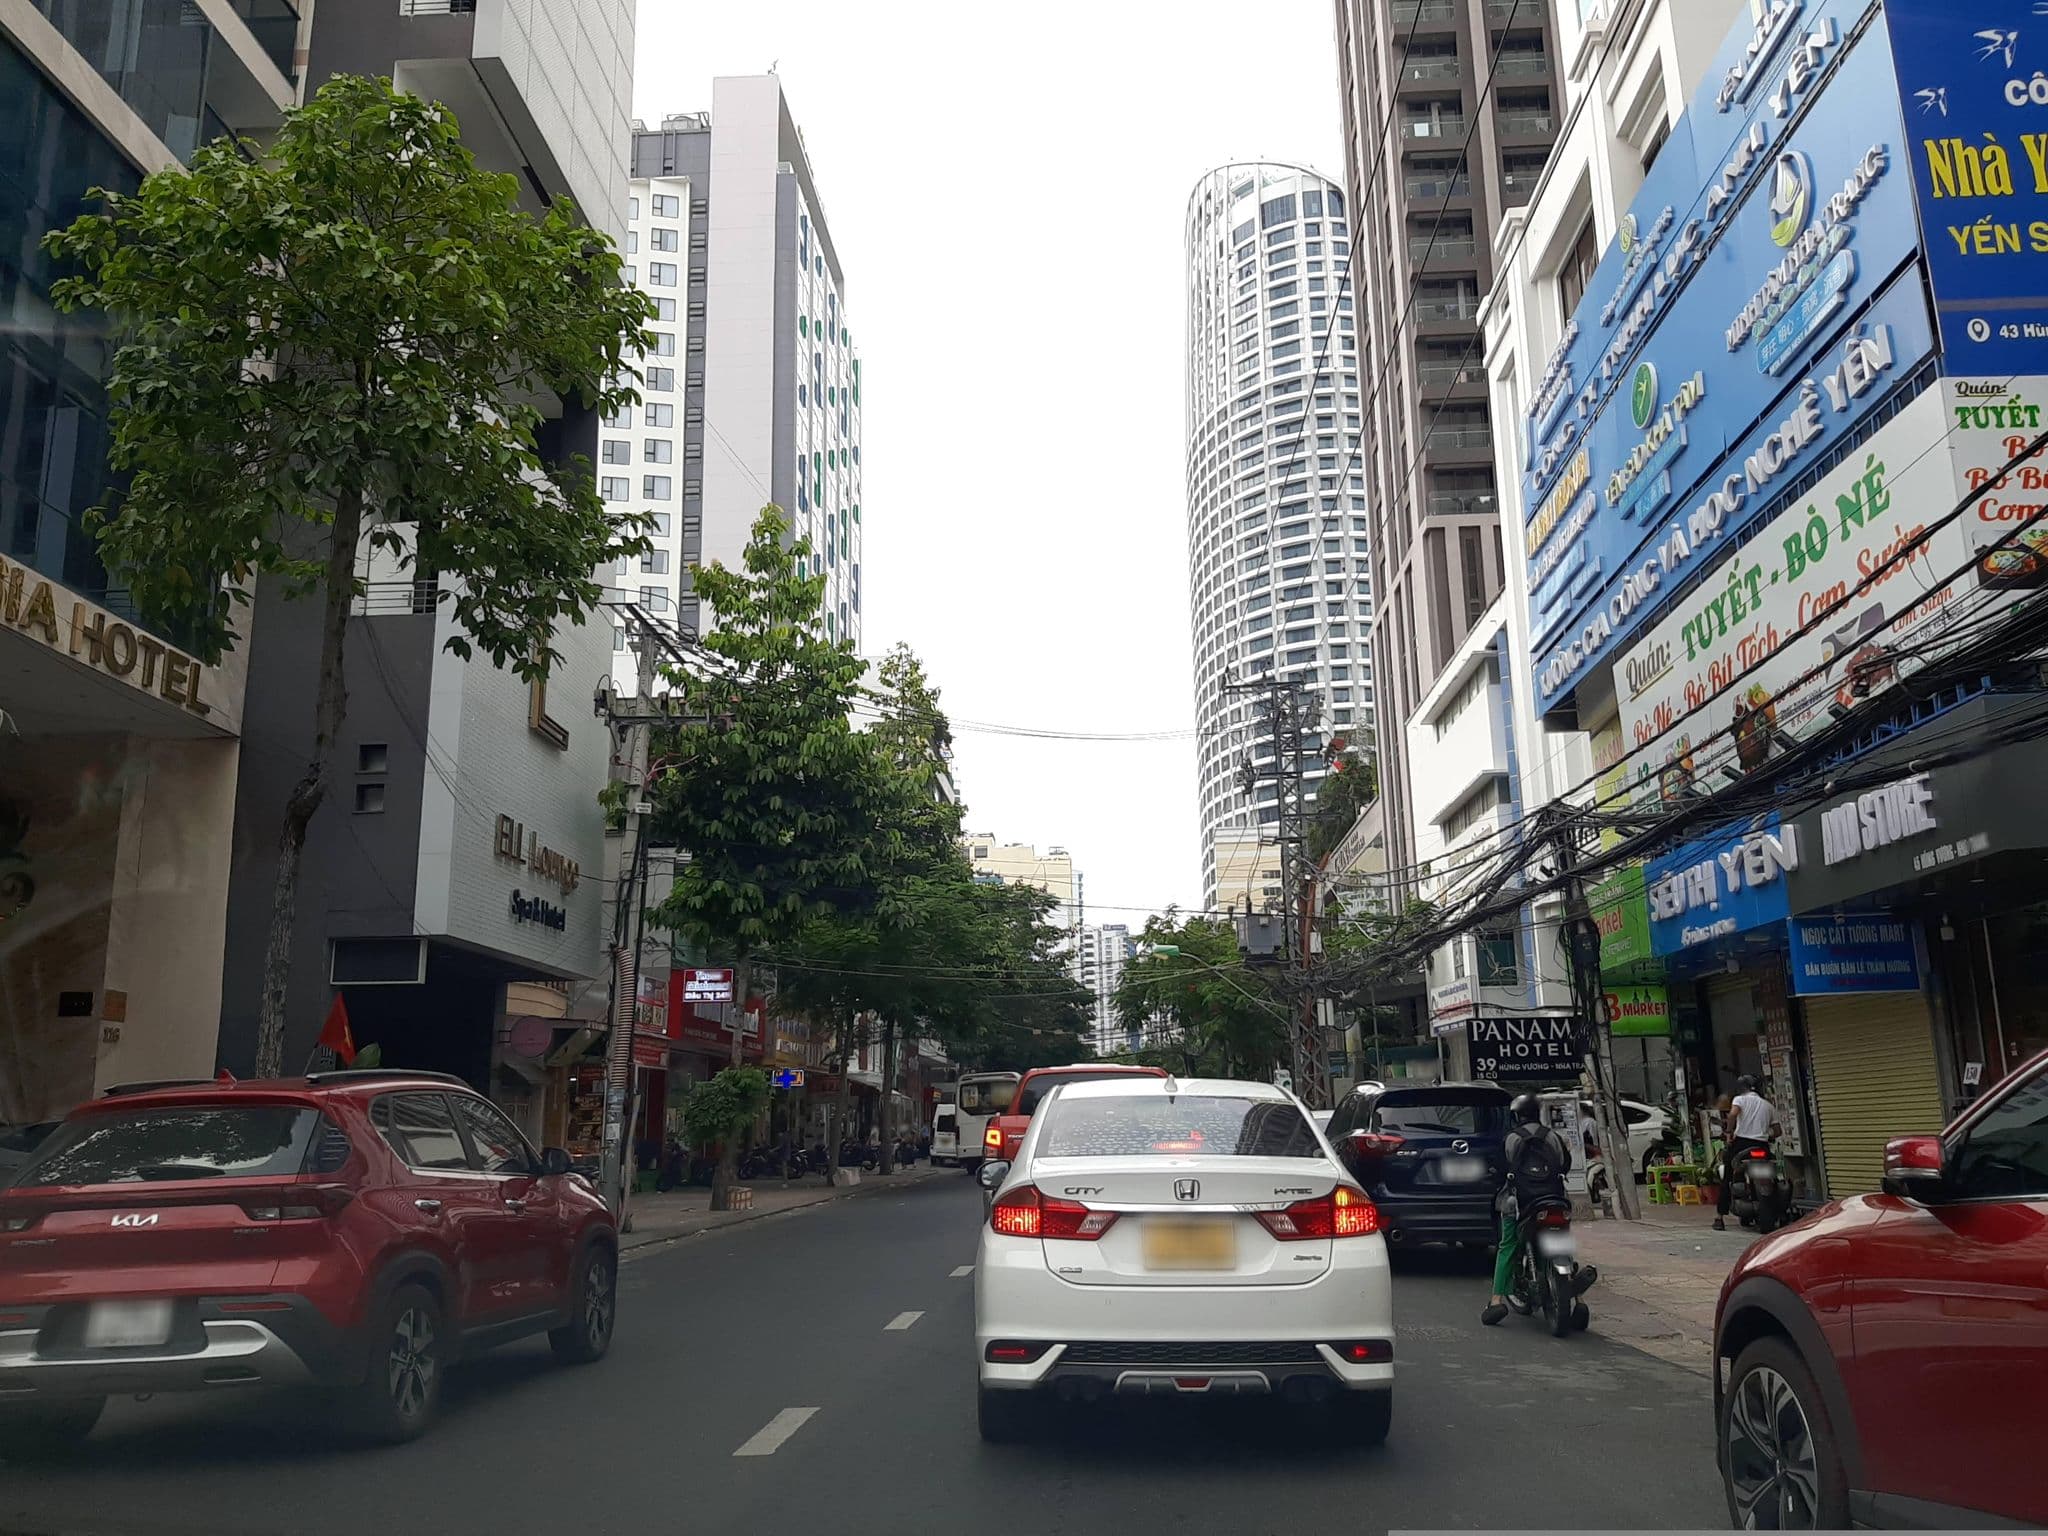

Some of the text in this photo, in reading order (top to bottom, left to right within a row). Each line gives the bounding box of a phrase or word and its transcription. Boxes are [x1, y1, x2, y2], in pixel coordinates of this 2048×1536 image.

[1924, 132, 2014, 199] Nhà
[1822, 144, 1885, 239] TRANG
[1533, 420, 1575, 490] CÔNG
[1575, 377, 1600, 419] TY
[1768, 17, 1834, 118] YẾN
[1947, 214, 2022, 256] YẾN
[1999, 324, 2019, 338] 43
[1954, 380, 2008, 396] Quán:
[1954, 394, 2042, 430] TUYẾT
[1610, 557, 1661, 627] CÔNG
[1657, 522, 1691, 573] VÀ
[1688, 473, 1746, 548] HỌC
[1743, 377, 1825, 495] NGHỀ
[1823, 322, 1895, 413] YẾN
[1625, 639, 1672, 694] Quán:
[1681, 558, 1762, 662] TUYẾT
[1783, 504, 1829, 583] BÒ
[1835, 453, 1890, 543] NÉ
[70, 602, 211, 715] HOTEL
[1633, 713, 1653, 746] Bò
[1653, 696, 1673, 735] Né
[1683, 673, 1708, 713] Bò
[1707, 652, 1734, 695] Bít
[1736, 622, 1778, 672] Tếch
[1798, 580, 1850, 634] Cơm
[1858, 772, 1937, 850] STORE
[1717, 813, 1799, 893] YẾN
[1801, 926, 1827, 950] NGỌC
[1880, 923, 1906, 945] MART
[1623, 1001, 1666, 1016] MARKET
[1471, 1019, 1592, 1041] PANAM
[1500, 1043, 1573, 1057] HOTEL
[1476, 1058, 1497, 1071] 39
[1064, 1187, 1104, 1195] CITY
